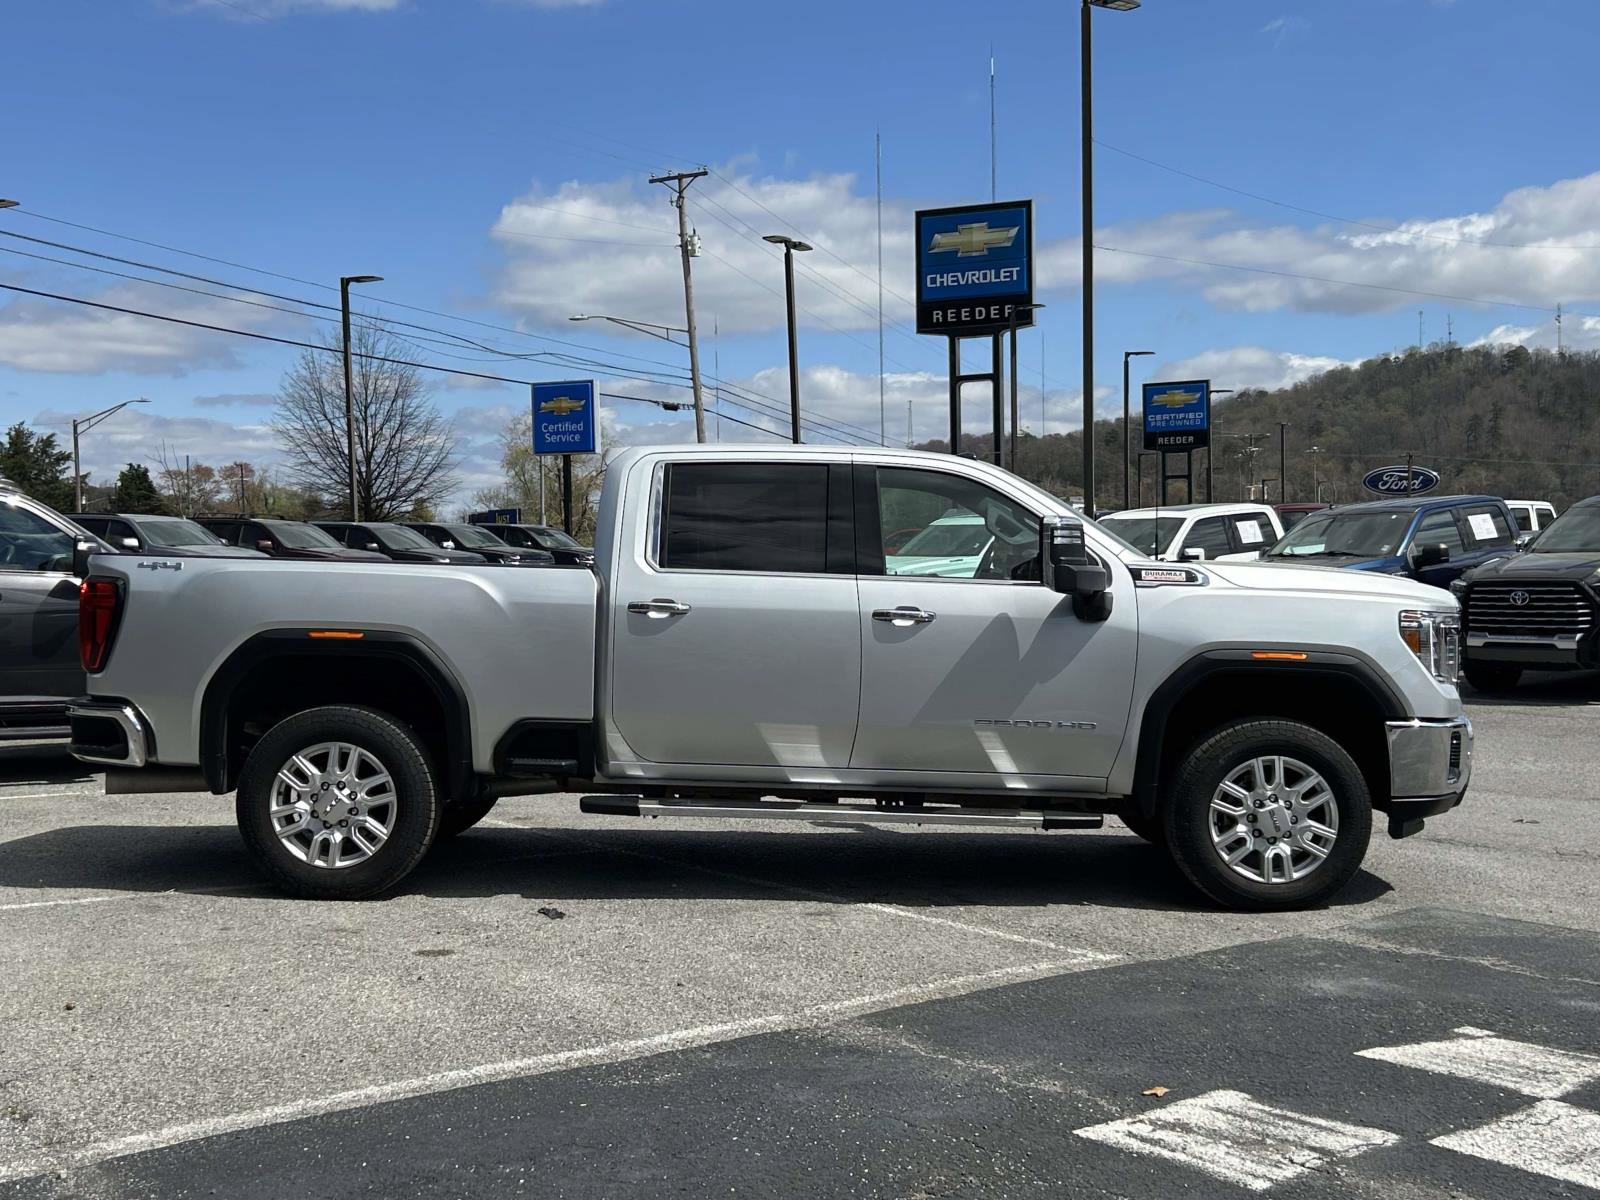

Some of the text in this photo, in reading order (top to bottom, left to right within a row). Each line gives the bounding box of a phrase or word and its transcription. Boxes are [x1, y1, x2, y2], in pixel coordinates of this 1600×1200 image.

[926, 267, 1020, 288] CHEVROLET
[1148, 412, 1203, 421] CERTIFIED
[541, 421, 584, 432] Certified
[545, 433, 581, 442] Service
[1158, 436, 1194, 445] REEDER
[1378, 471, 1423, 490] Ford
